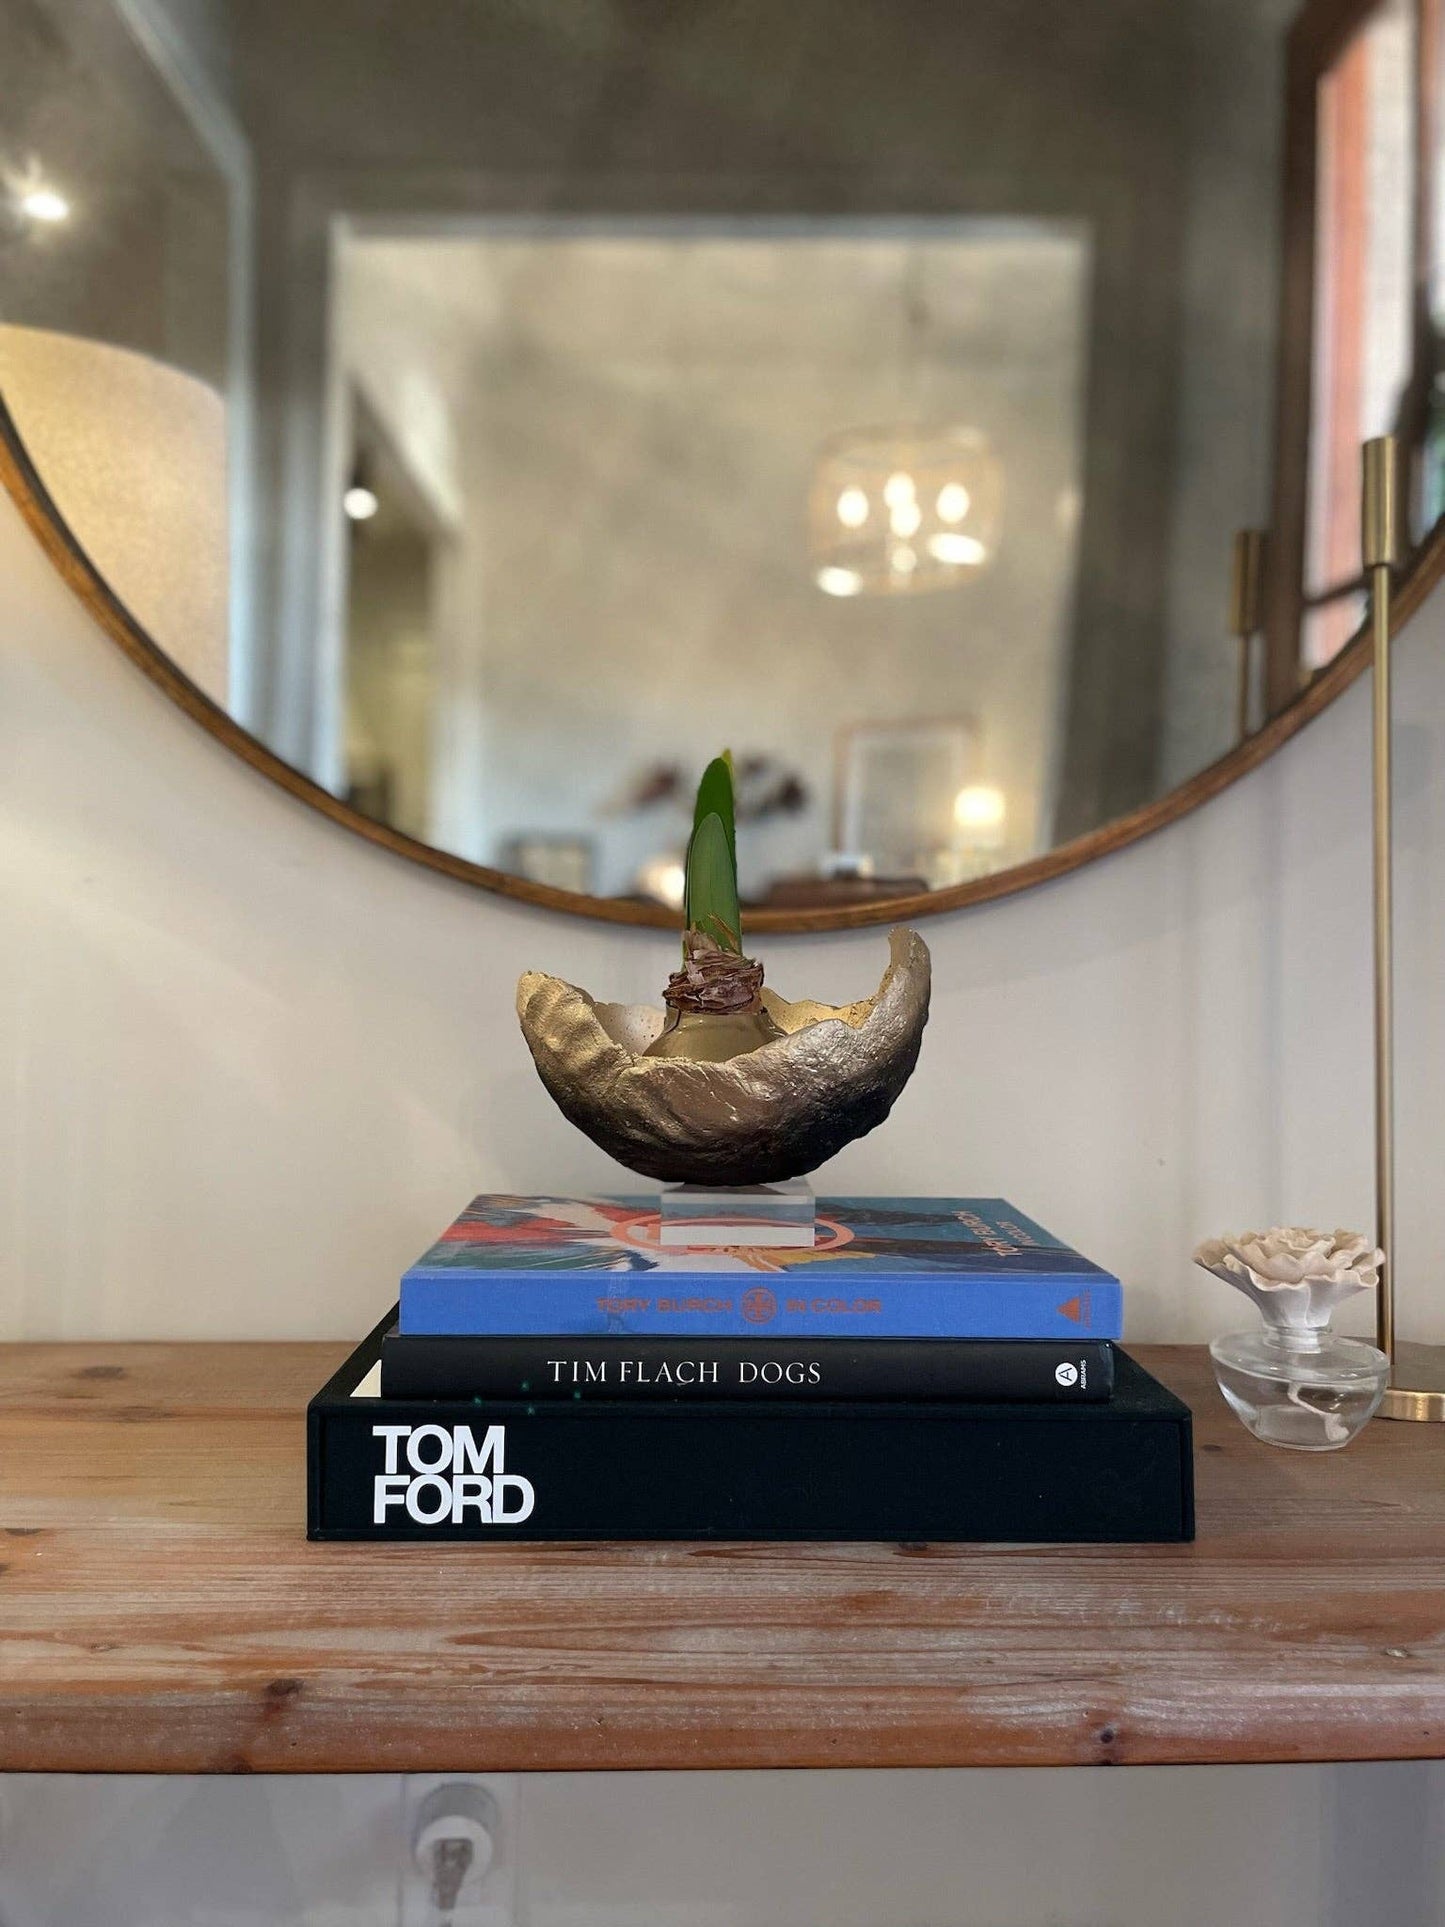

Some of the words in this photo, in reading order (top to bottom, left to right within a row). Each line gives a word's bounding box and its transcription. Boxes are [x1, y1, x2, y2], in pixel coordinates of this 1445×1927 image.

[951, 1210, 998, 1236] BURCH
[979, 1235, 1024, 1257] TORY
[597, 1298, 651, 1313] TORY
[657, 1298, 733, 1313] BURCH
[786, 1298, 807, 1313] IN
[811, 1298, 882, 1314] COLOR
[547, 1361, 606, 1382] TIM
[619, 1361, 719, 1385] FLACH
[738, 1361, 822, 1384] DOGS
[372, 1424, 505, 1474] TOM
[373, 1474, 535, 1525] FORD
